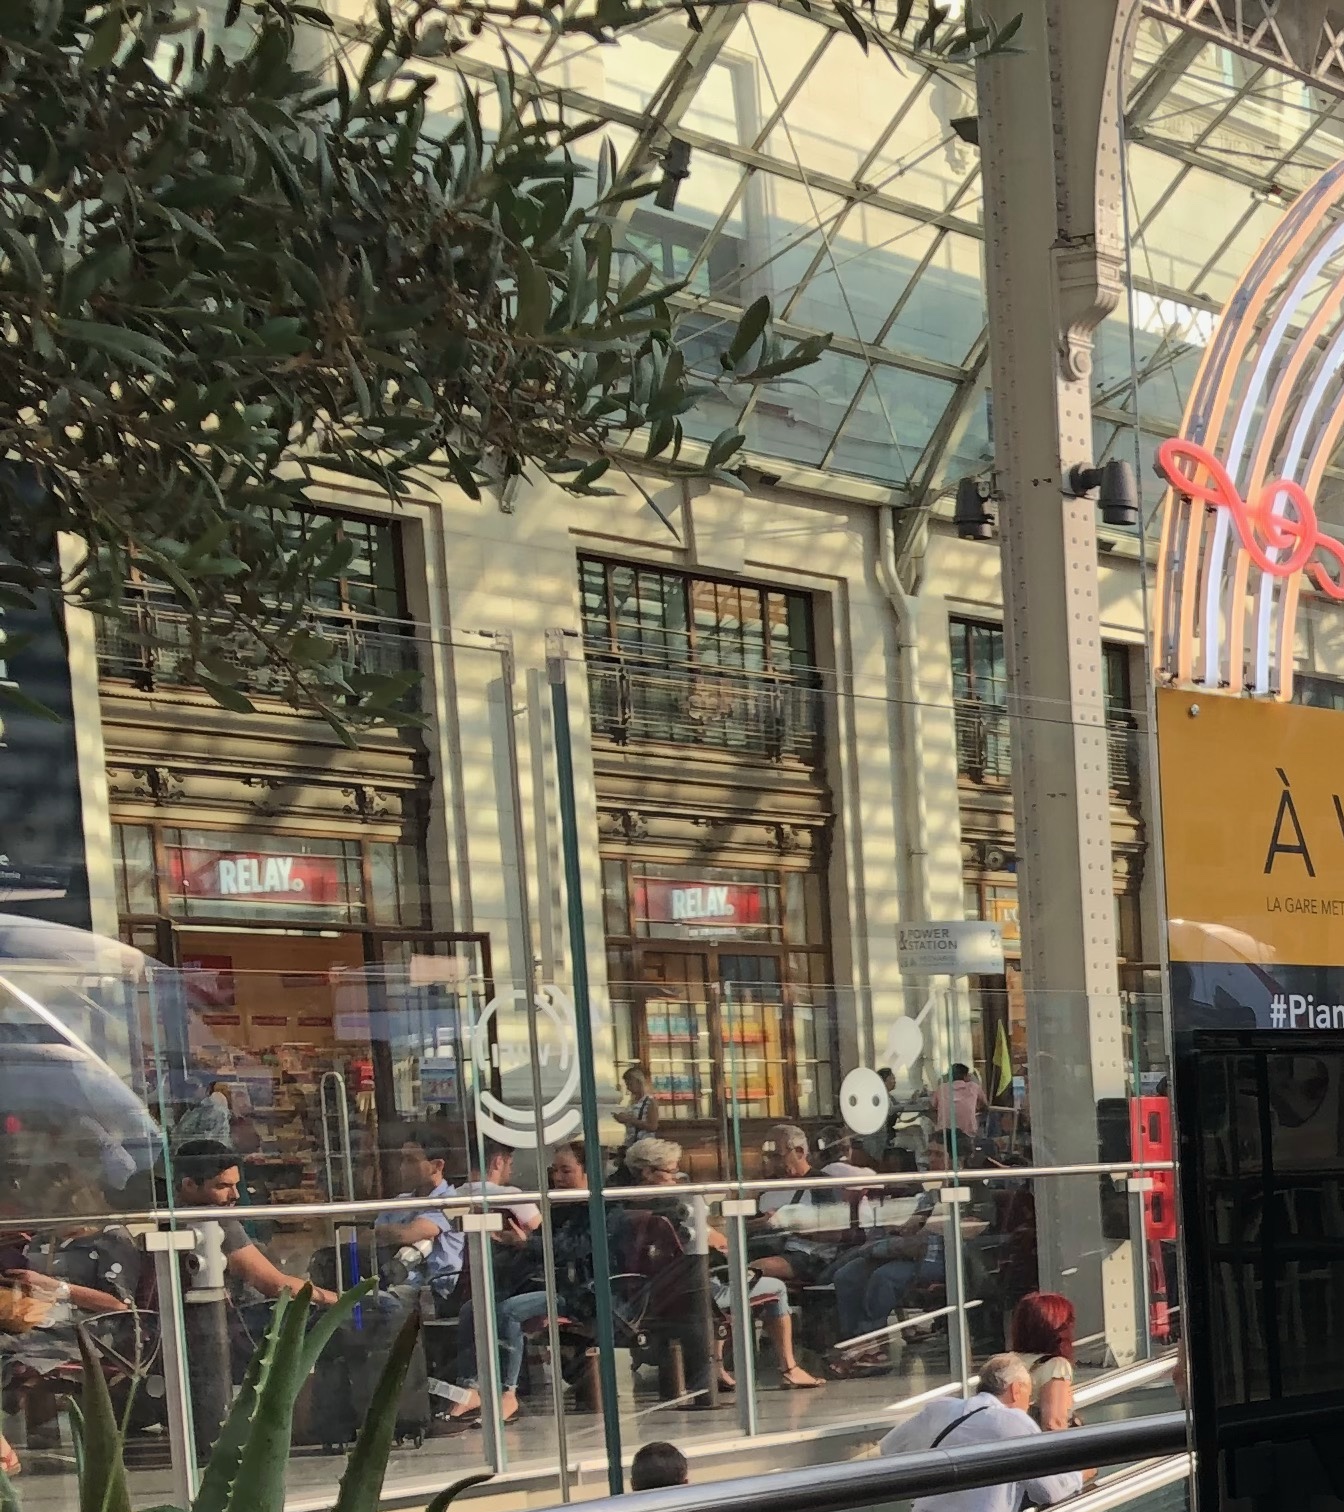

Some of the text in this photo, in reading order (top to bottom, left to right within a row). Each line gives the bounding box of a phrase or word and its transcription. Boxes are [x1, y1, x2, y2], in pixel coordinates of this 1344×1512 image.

[1263, 767, 1316, 877] À
[219, 857, 293, 895] RELAY
[672, 886, 729, 919] RELAY
[1266, 897, 1282, 913] LA
[1284, 897, 1318, 915] GARE
[907, 940, 957, 950] STATION
